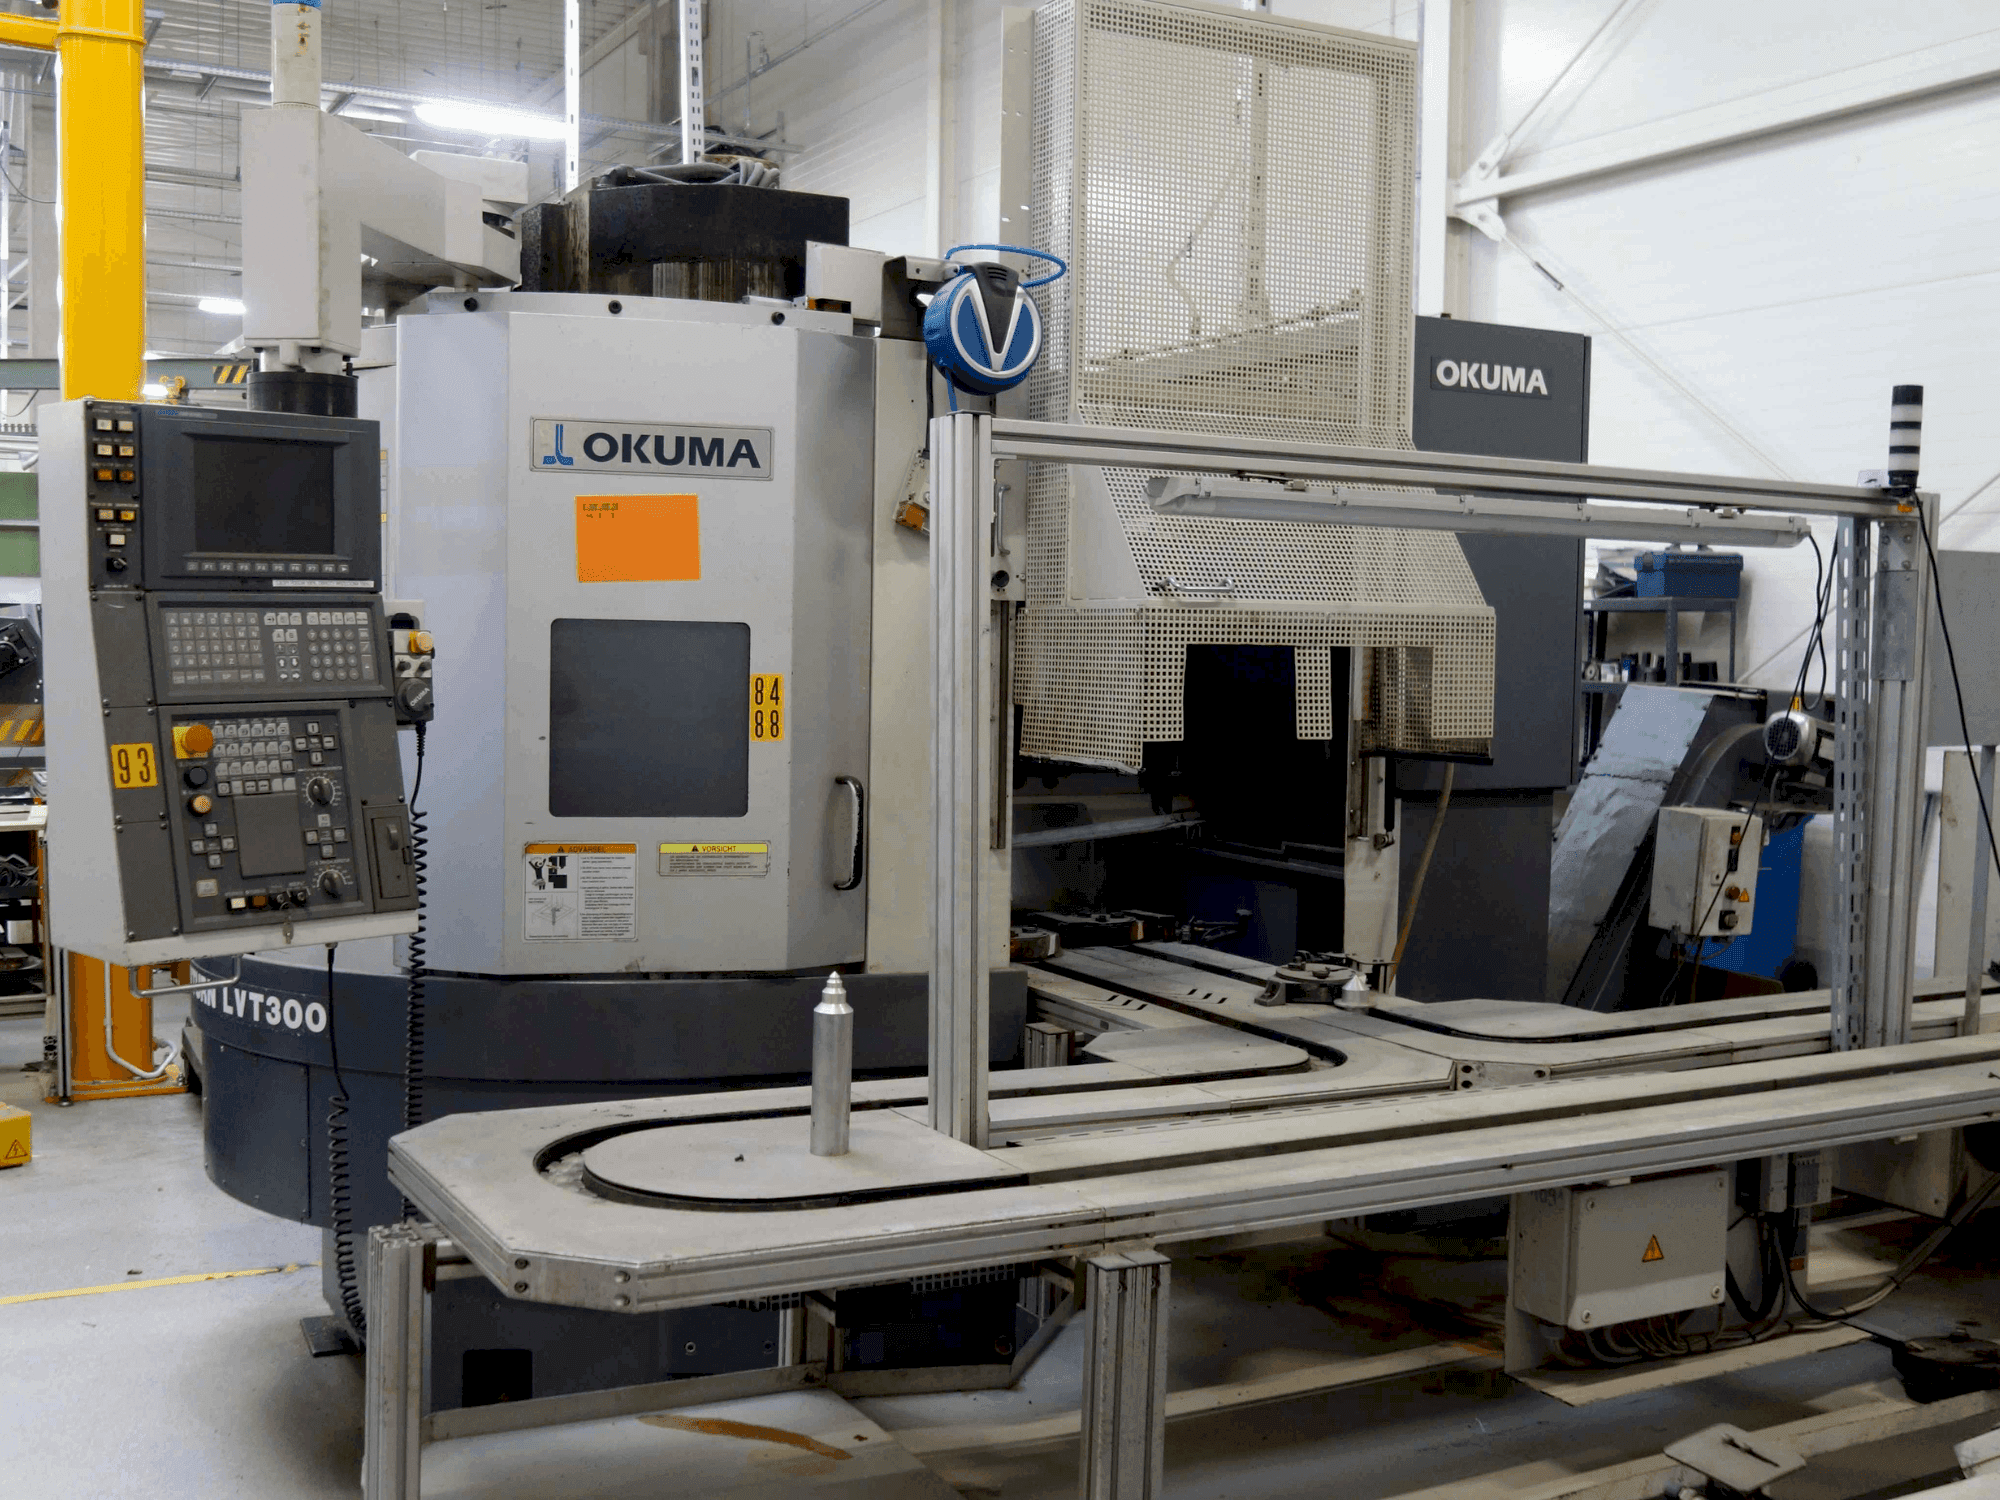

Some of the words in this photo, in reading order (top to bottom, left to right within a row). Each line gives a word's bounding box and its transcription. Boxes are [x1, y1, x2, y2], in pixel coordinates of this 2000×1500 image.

[1436, 360, 1548, 395] OKUMA
[583, 432, 761, 468] OKUMA
[410, 687, 430, 706] OKUMA
[755, 677, 780, 706] 84
[755, 710, 780, 738] 88
[118, 748, 150, 784] 93
[701, 845, 736, 853] VORSICHT
[222, 986, 327, 1033] LVT300
